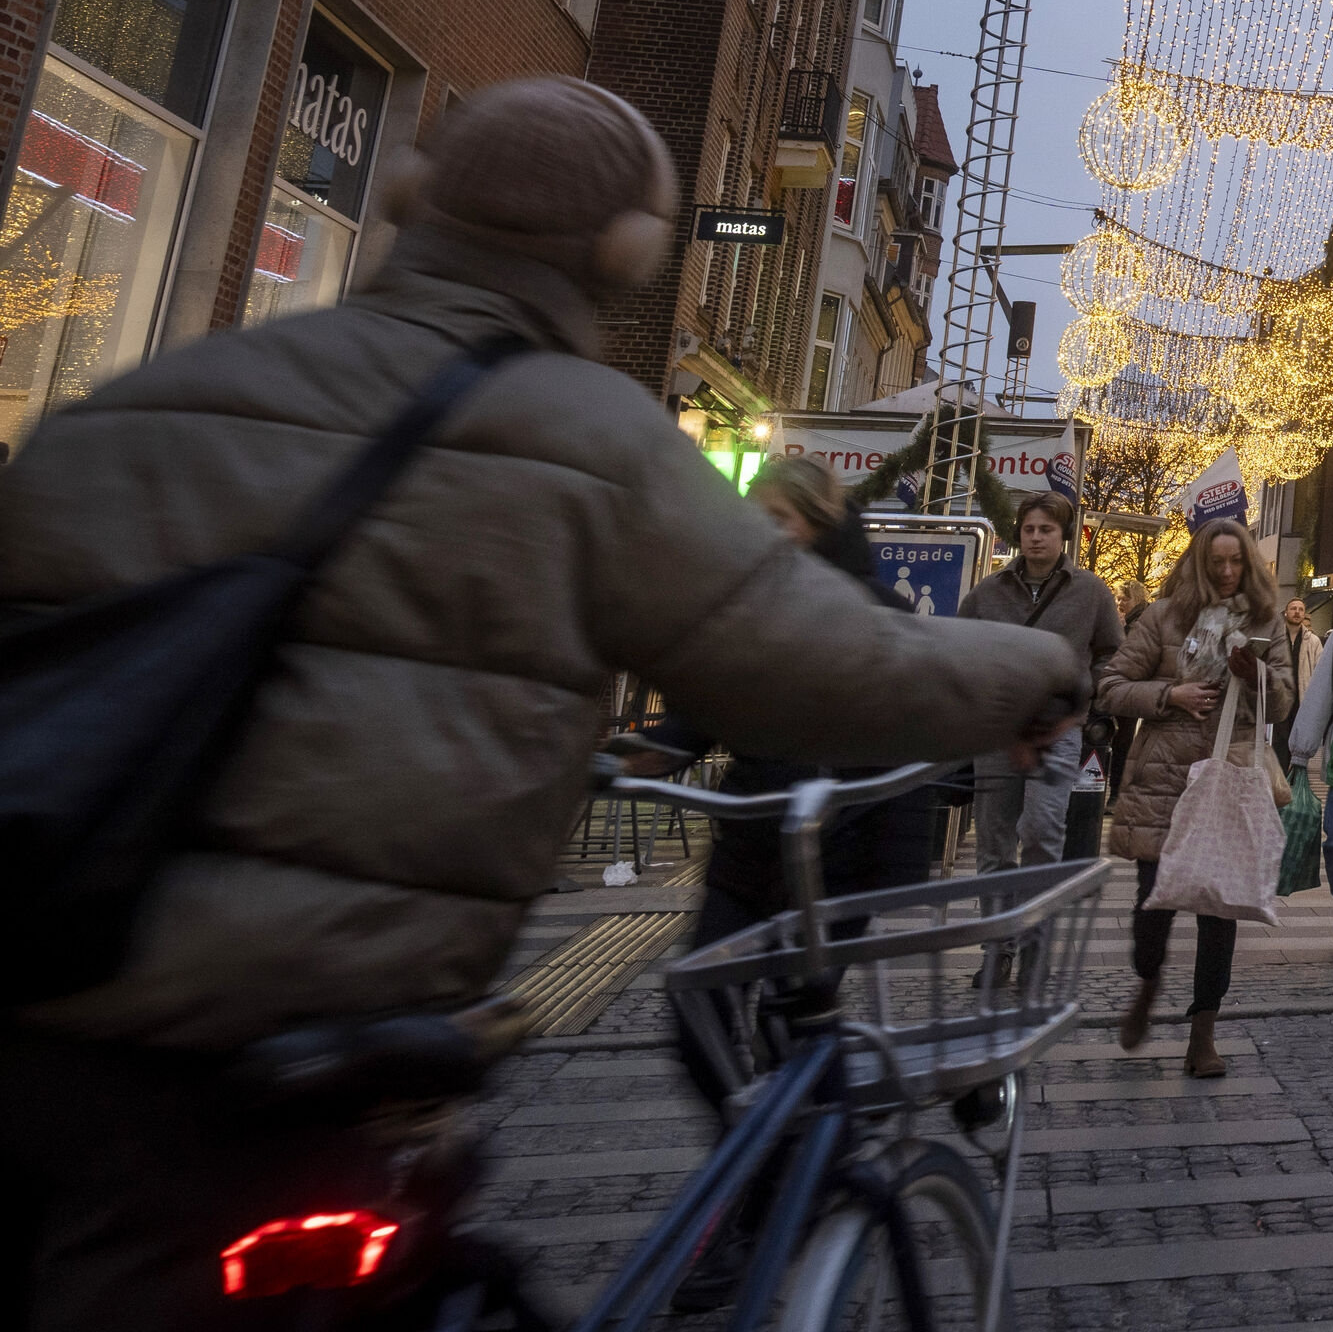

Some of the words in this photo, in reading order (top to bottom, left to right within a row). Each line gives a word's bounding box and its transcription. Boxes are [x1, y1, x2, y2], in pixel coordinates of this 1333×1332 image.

[715, 221, 767, 236] matas
[985, 451, 1048, 475] onto
[1202, 482, 1234, 499] STEFF
[1204, 490, 1237, 505] HOULBERG
[1203, 506, 1216, 515] MED
[1215, 503, 1226, 511] DET
[1226, 497, 1239, 507] HELE
[880, 546, 953, 563] Gågade
